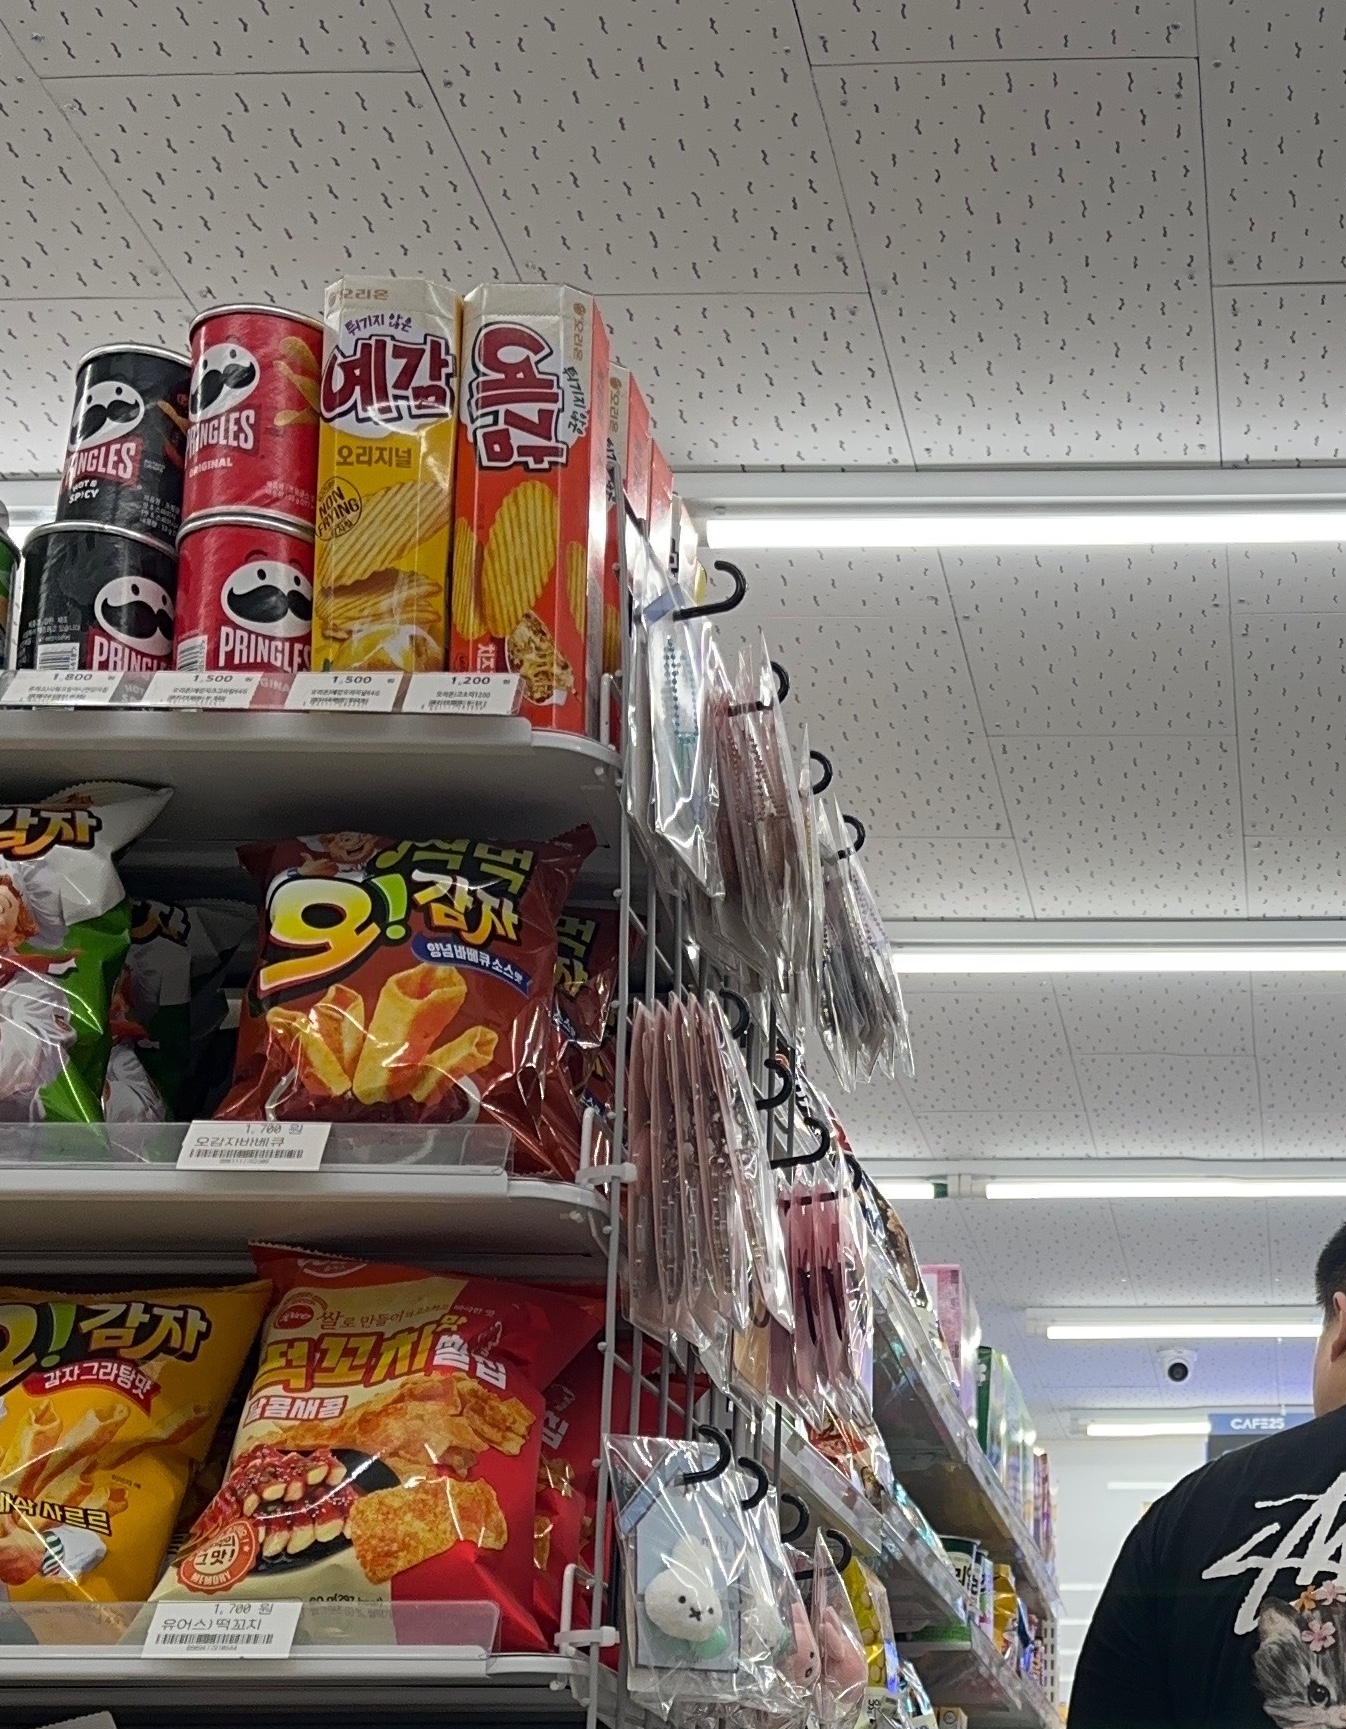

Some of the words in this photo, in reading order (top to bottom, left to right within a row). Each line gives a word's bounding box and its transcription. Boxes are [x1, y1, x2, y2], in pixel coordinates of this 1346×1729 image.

[345, 314, 385, 336] 튀기지
[321, 334, 453, 420] 예감
[472, 324, 567, 468] 예감
[336, 445, 412, 469] 오리지널
[317, 497, 360, 538] FRYING
[318, 486, 345, 519] NON
[194, 1137, 285, 1148] 오감자바베큐
[251, 1323, 434, 1392] 떡꼬치
[43, 1361, 154, 1400] 감자그라탕맛
[1230, 1416, 1285, 1431] CAFE25
[43, 1505, 109, 1534] 사르르
[213, 1603, 253, 1615] 1,700
